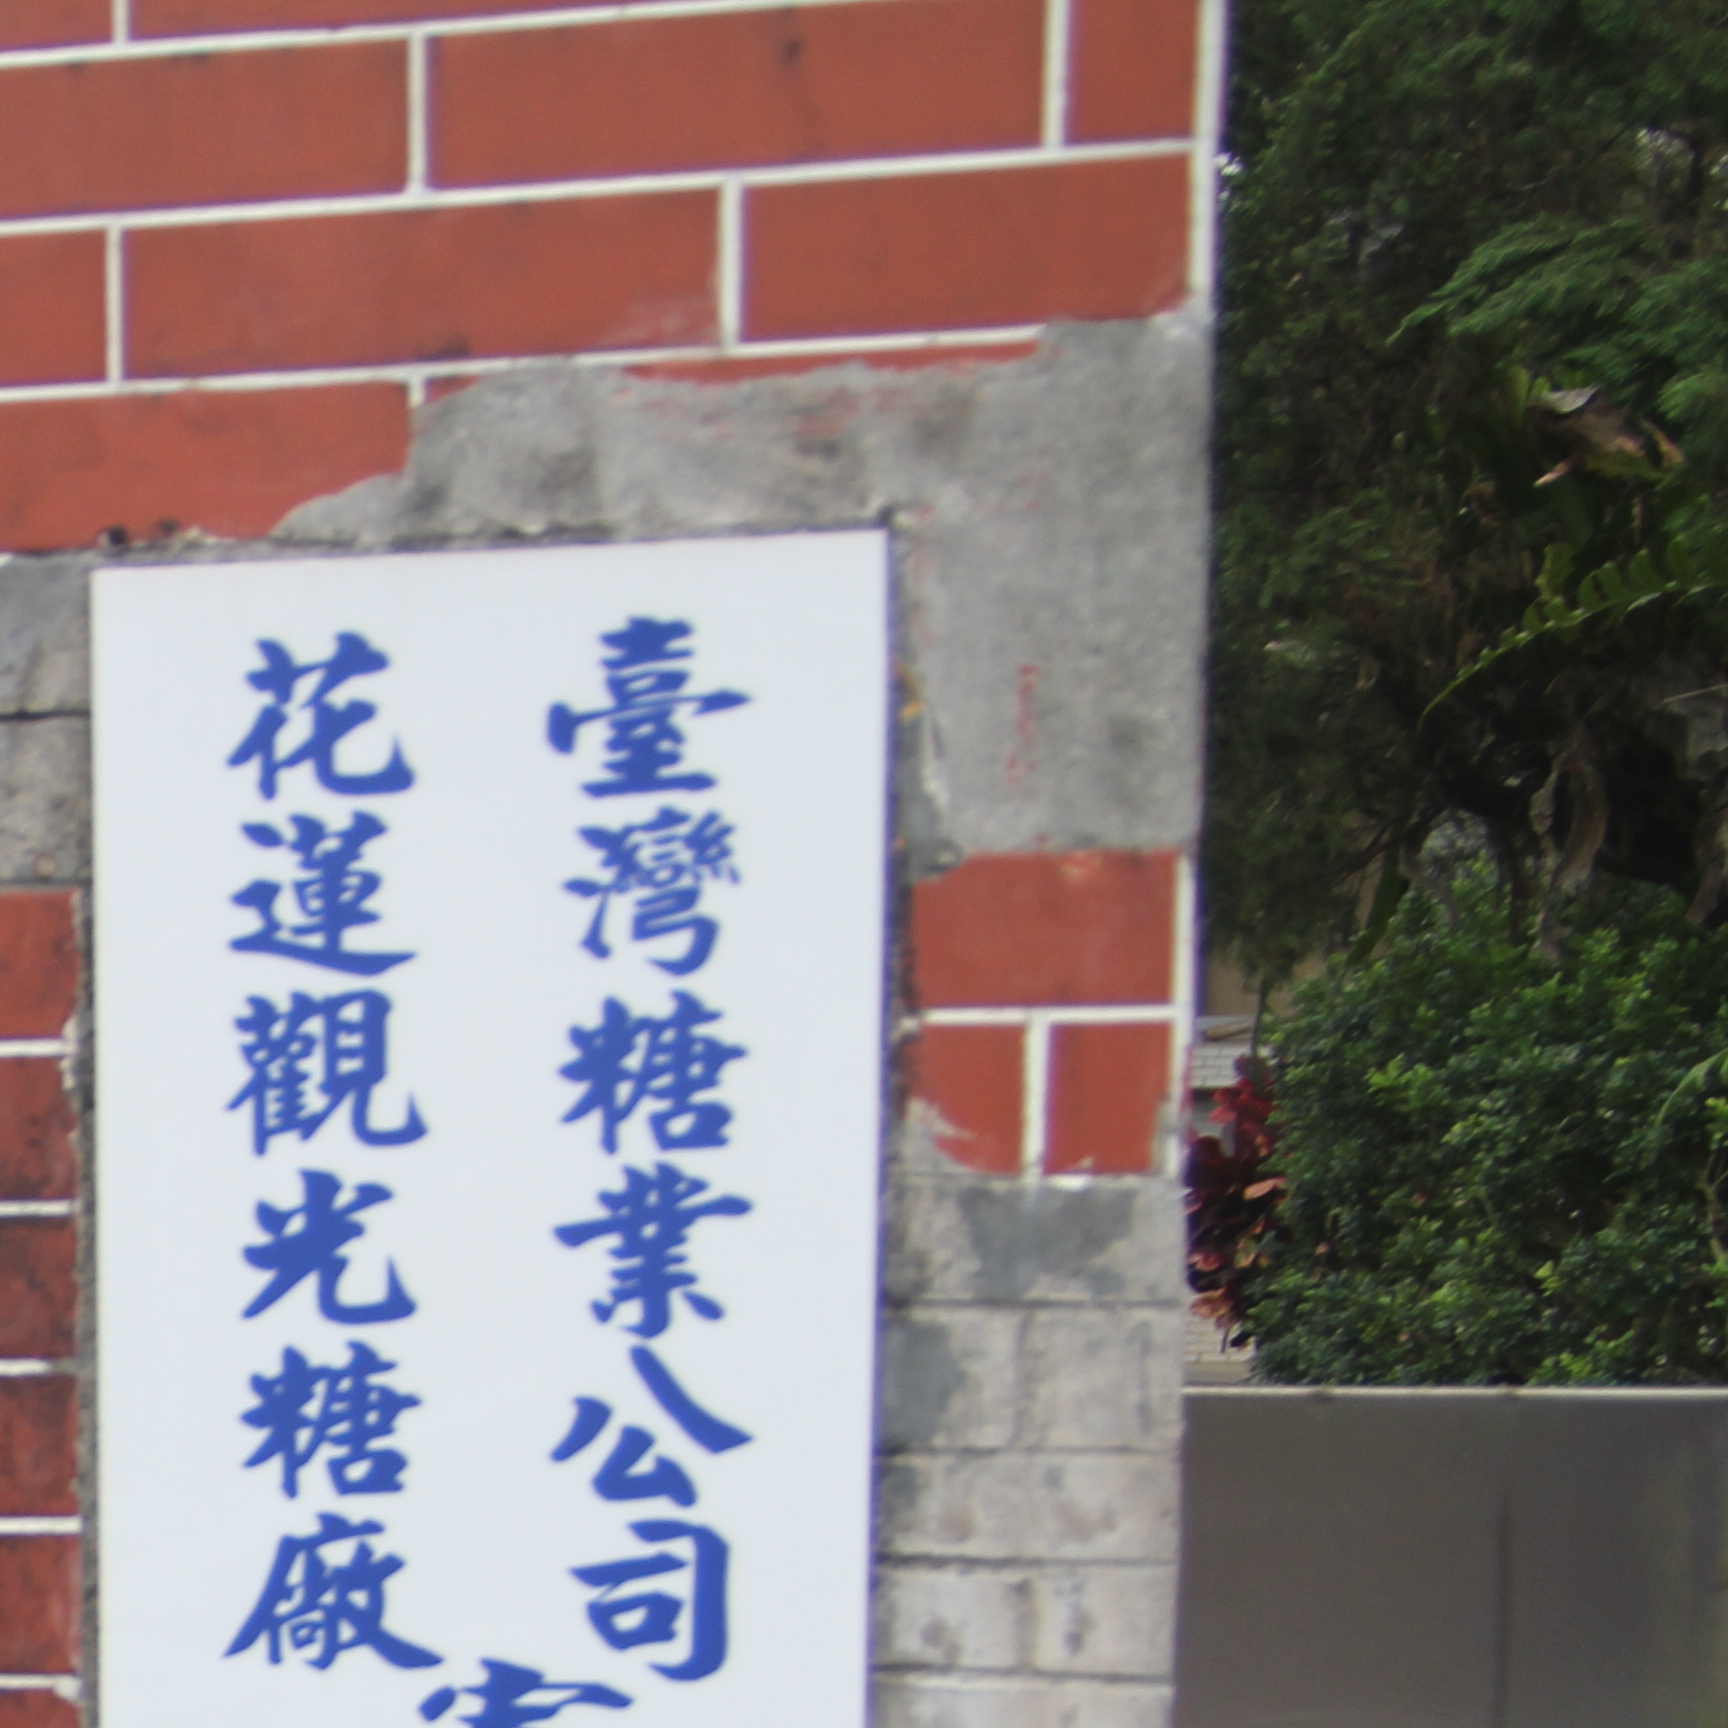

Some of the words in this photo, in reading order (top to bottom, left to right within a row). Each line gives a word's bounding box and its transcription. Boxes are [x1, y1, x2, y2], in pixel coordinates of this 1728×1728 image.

[223, 631, 445, 1671] 花蓮觀光糖廠
[545, 616, 753, 1683] 臺灣糖業公司
